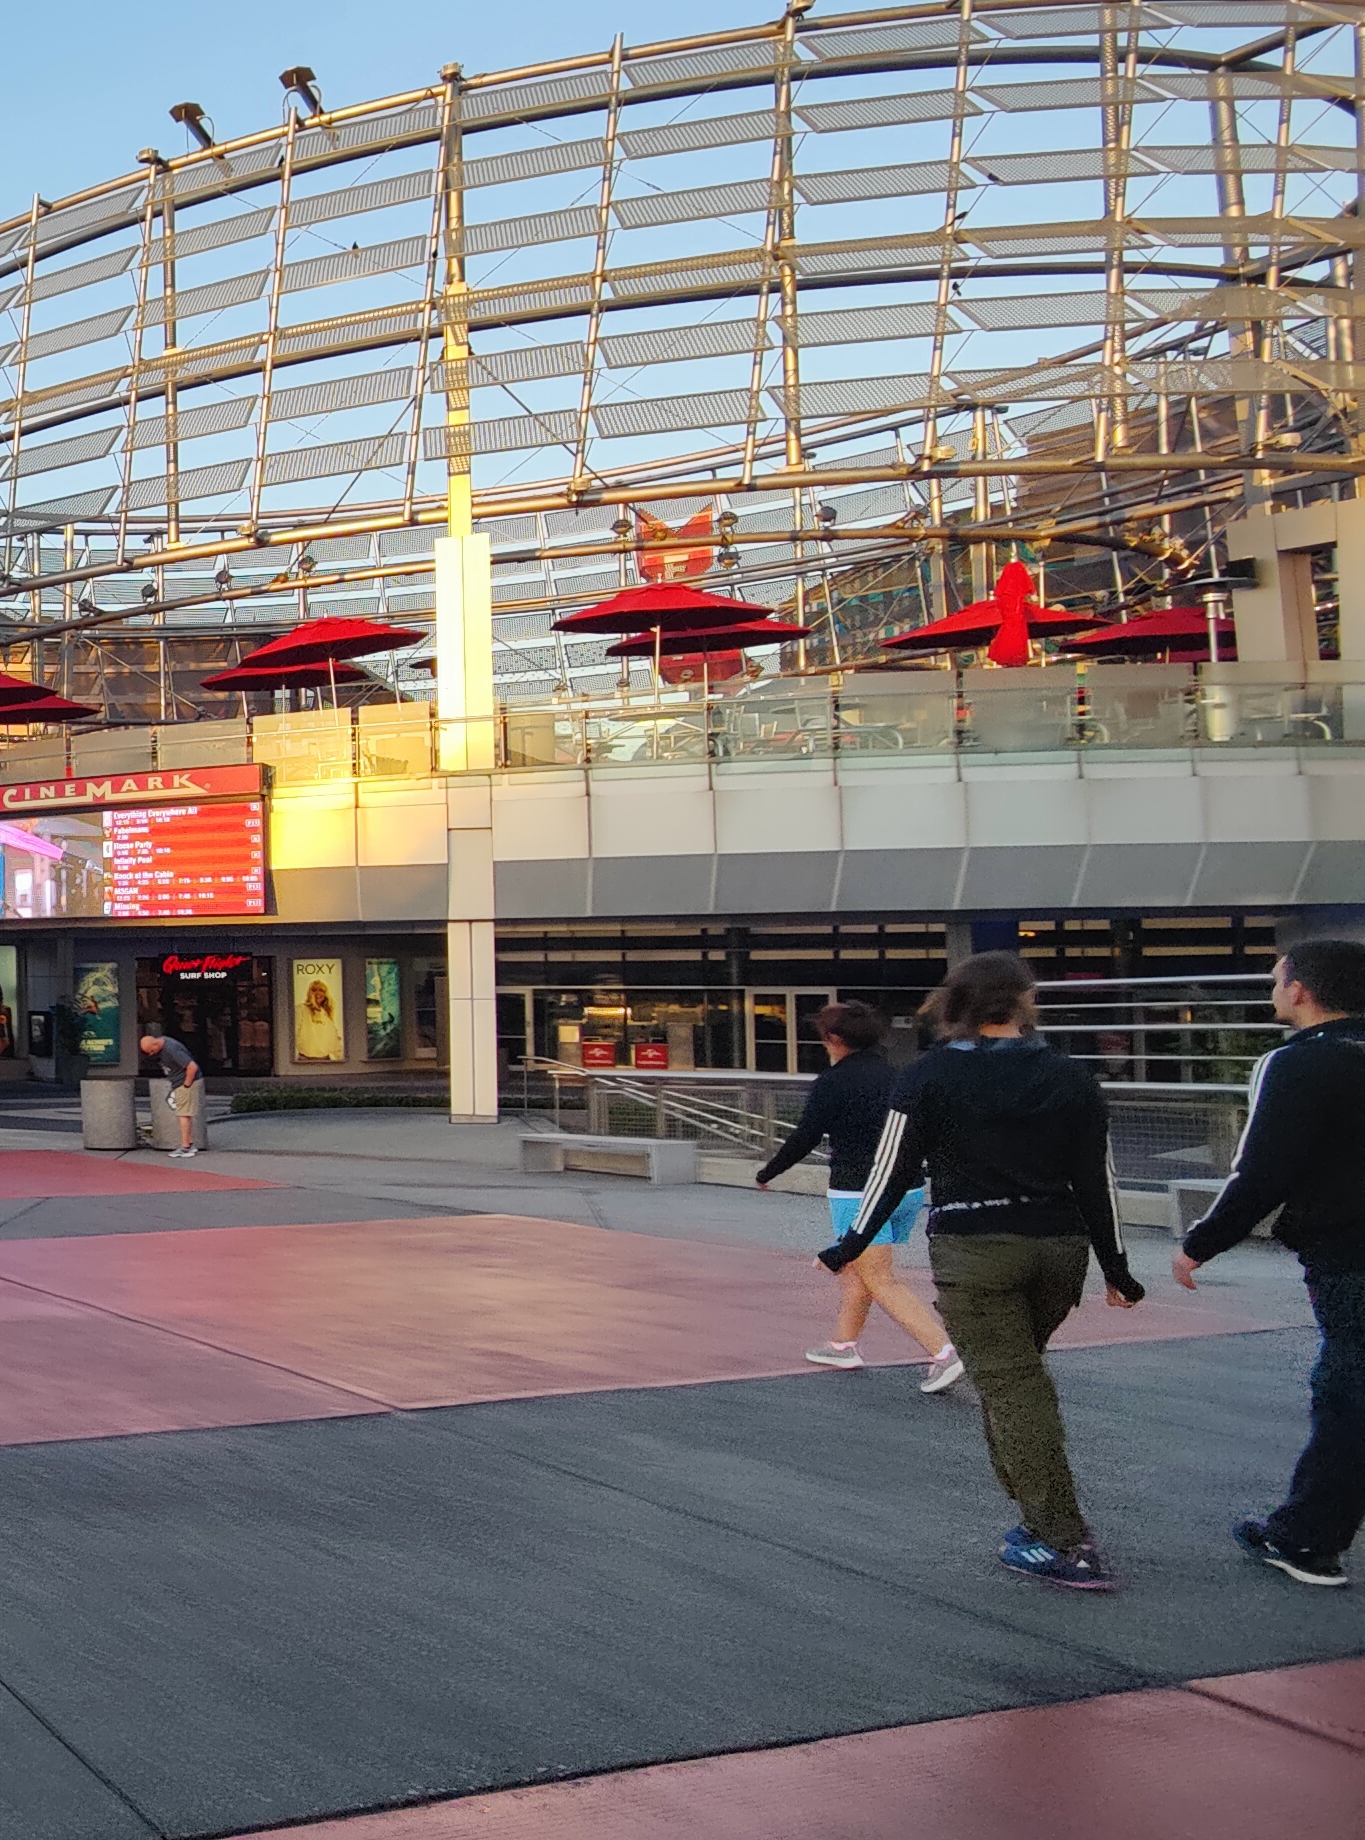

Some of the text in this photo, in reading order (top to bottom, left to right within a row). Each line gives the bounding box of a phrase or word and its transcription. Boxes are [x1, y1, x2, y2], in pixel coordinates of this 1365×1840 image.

[296, 963, 336, 975] ROXY
[180, 971, 227, 980] SURF SHOP
